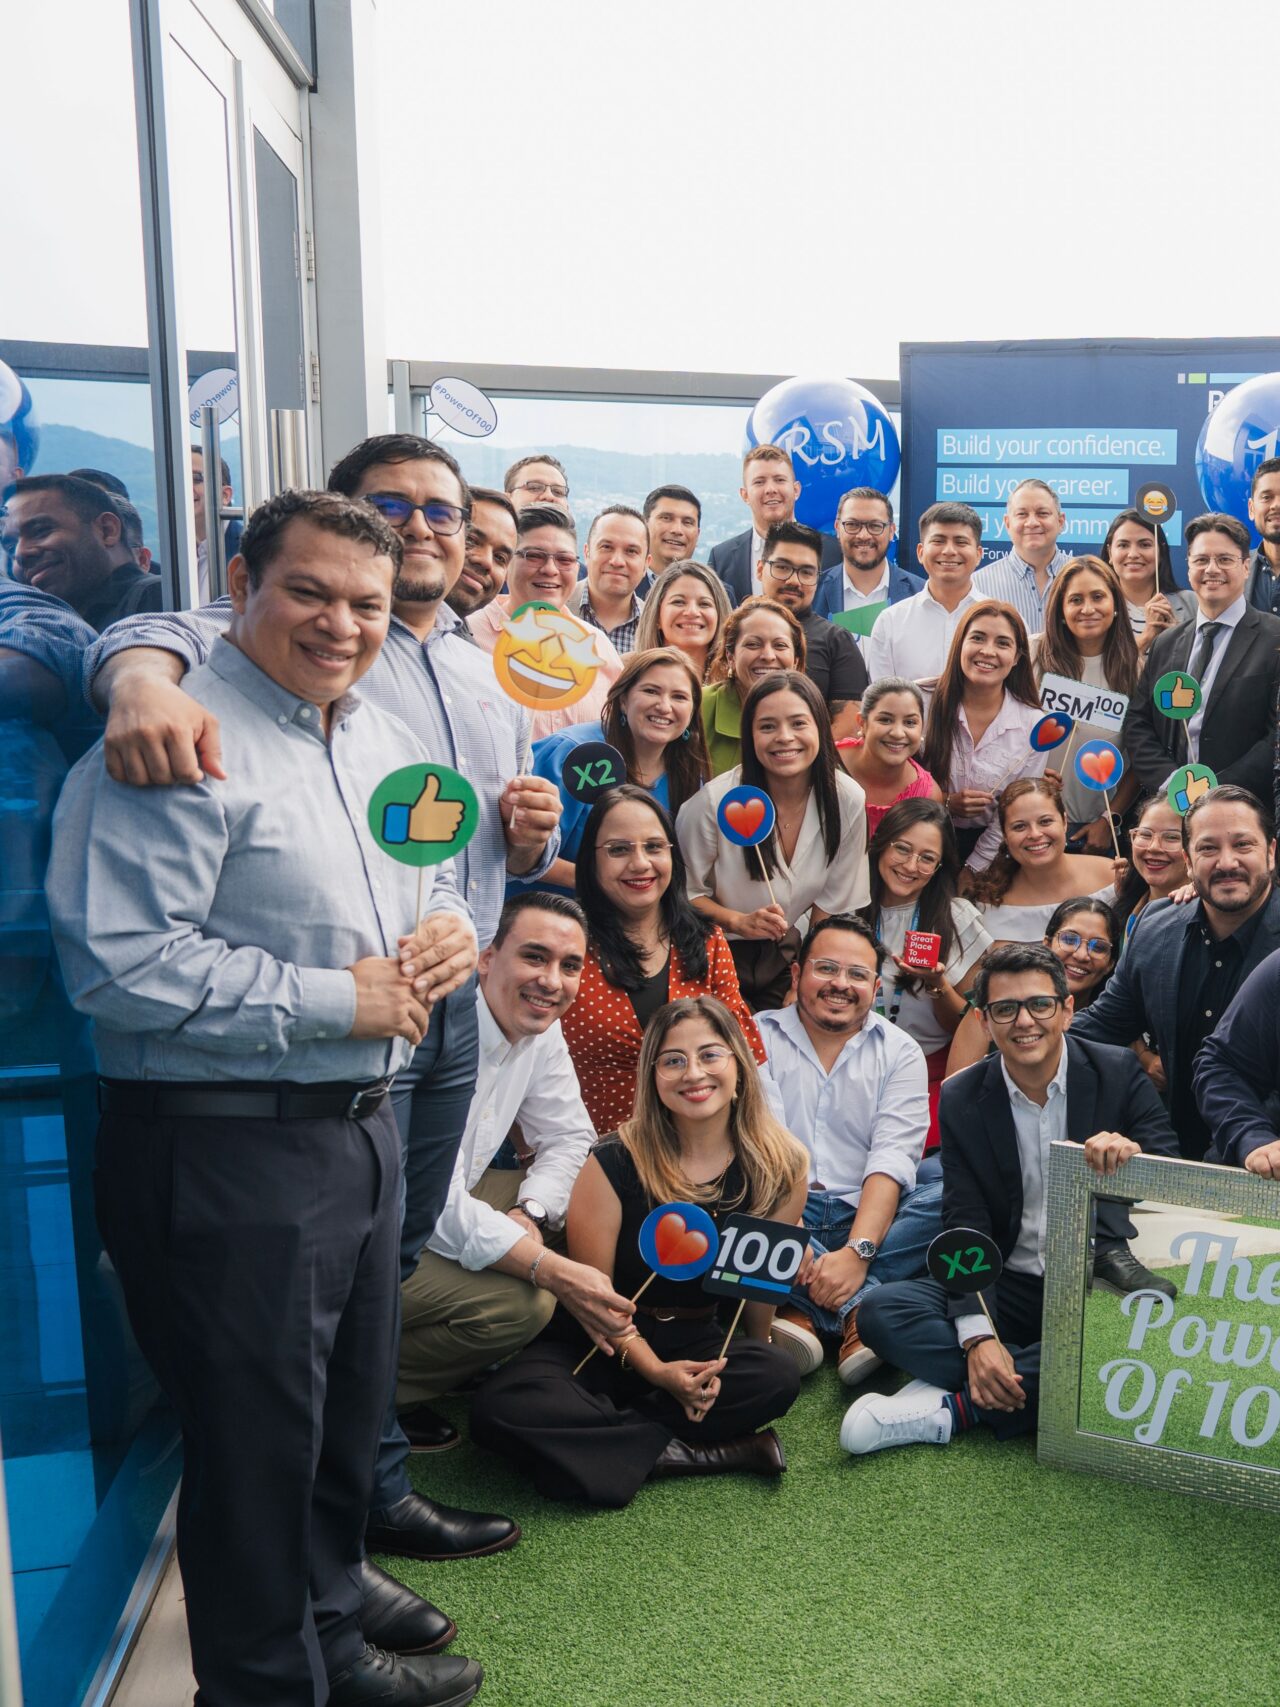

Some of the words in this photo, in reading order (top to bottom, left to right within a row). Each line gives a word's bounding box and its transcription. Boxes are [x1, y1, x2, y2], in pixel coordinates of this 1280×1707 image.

[434, 384, 492, 432] #PowerOf100
[772, 416, 886, 466] RSM
[943, 434, 990, 456] Build
[995, 439, 1042, 461] your
[1047, 434, 1166, 457] confidence.
[942, 473, 990, 495] Build
[995, 479, 1018, 499] yo
[1041, 688, 1094, 721] RSM
[1095, 695, 1124, 715] 100
[572, 759, 616, 791] X2
[909, 948, 917, 956] To
[910, 934, 933, 943] Great
[910, 941, 932, 951] Place
[908, 956, 930, 965] Work.
[716, 1226, 804, 1280] 100
[938, 1246, 992, 1280] X2
[1098, 1358, 1192, 1445] Of
